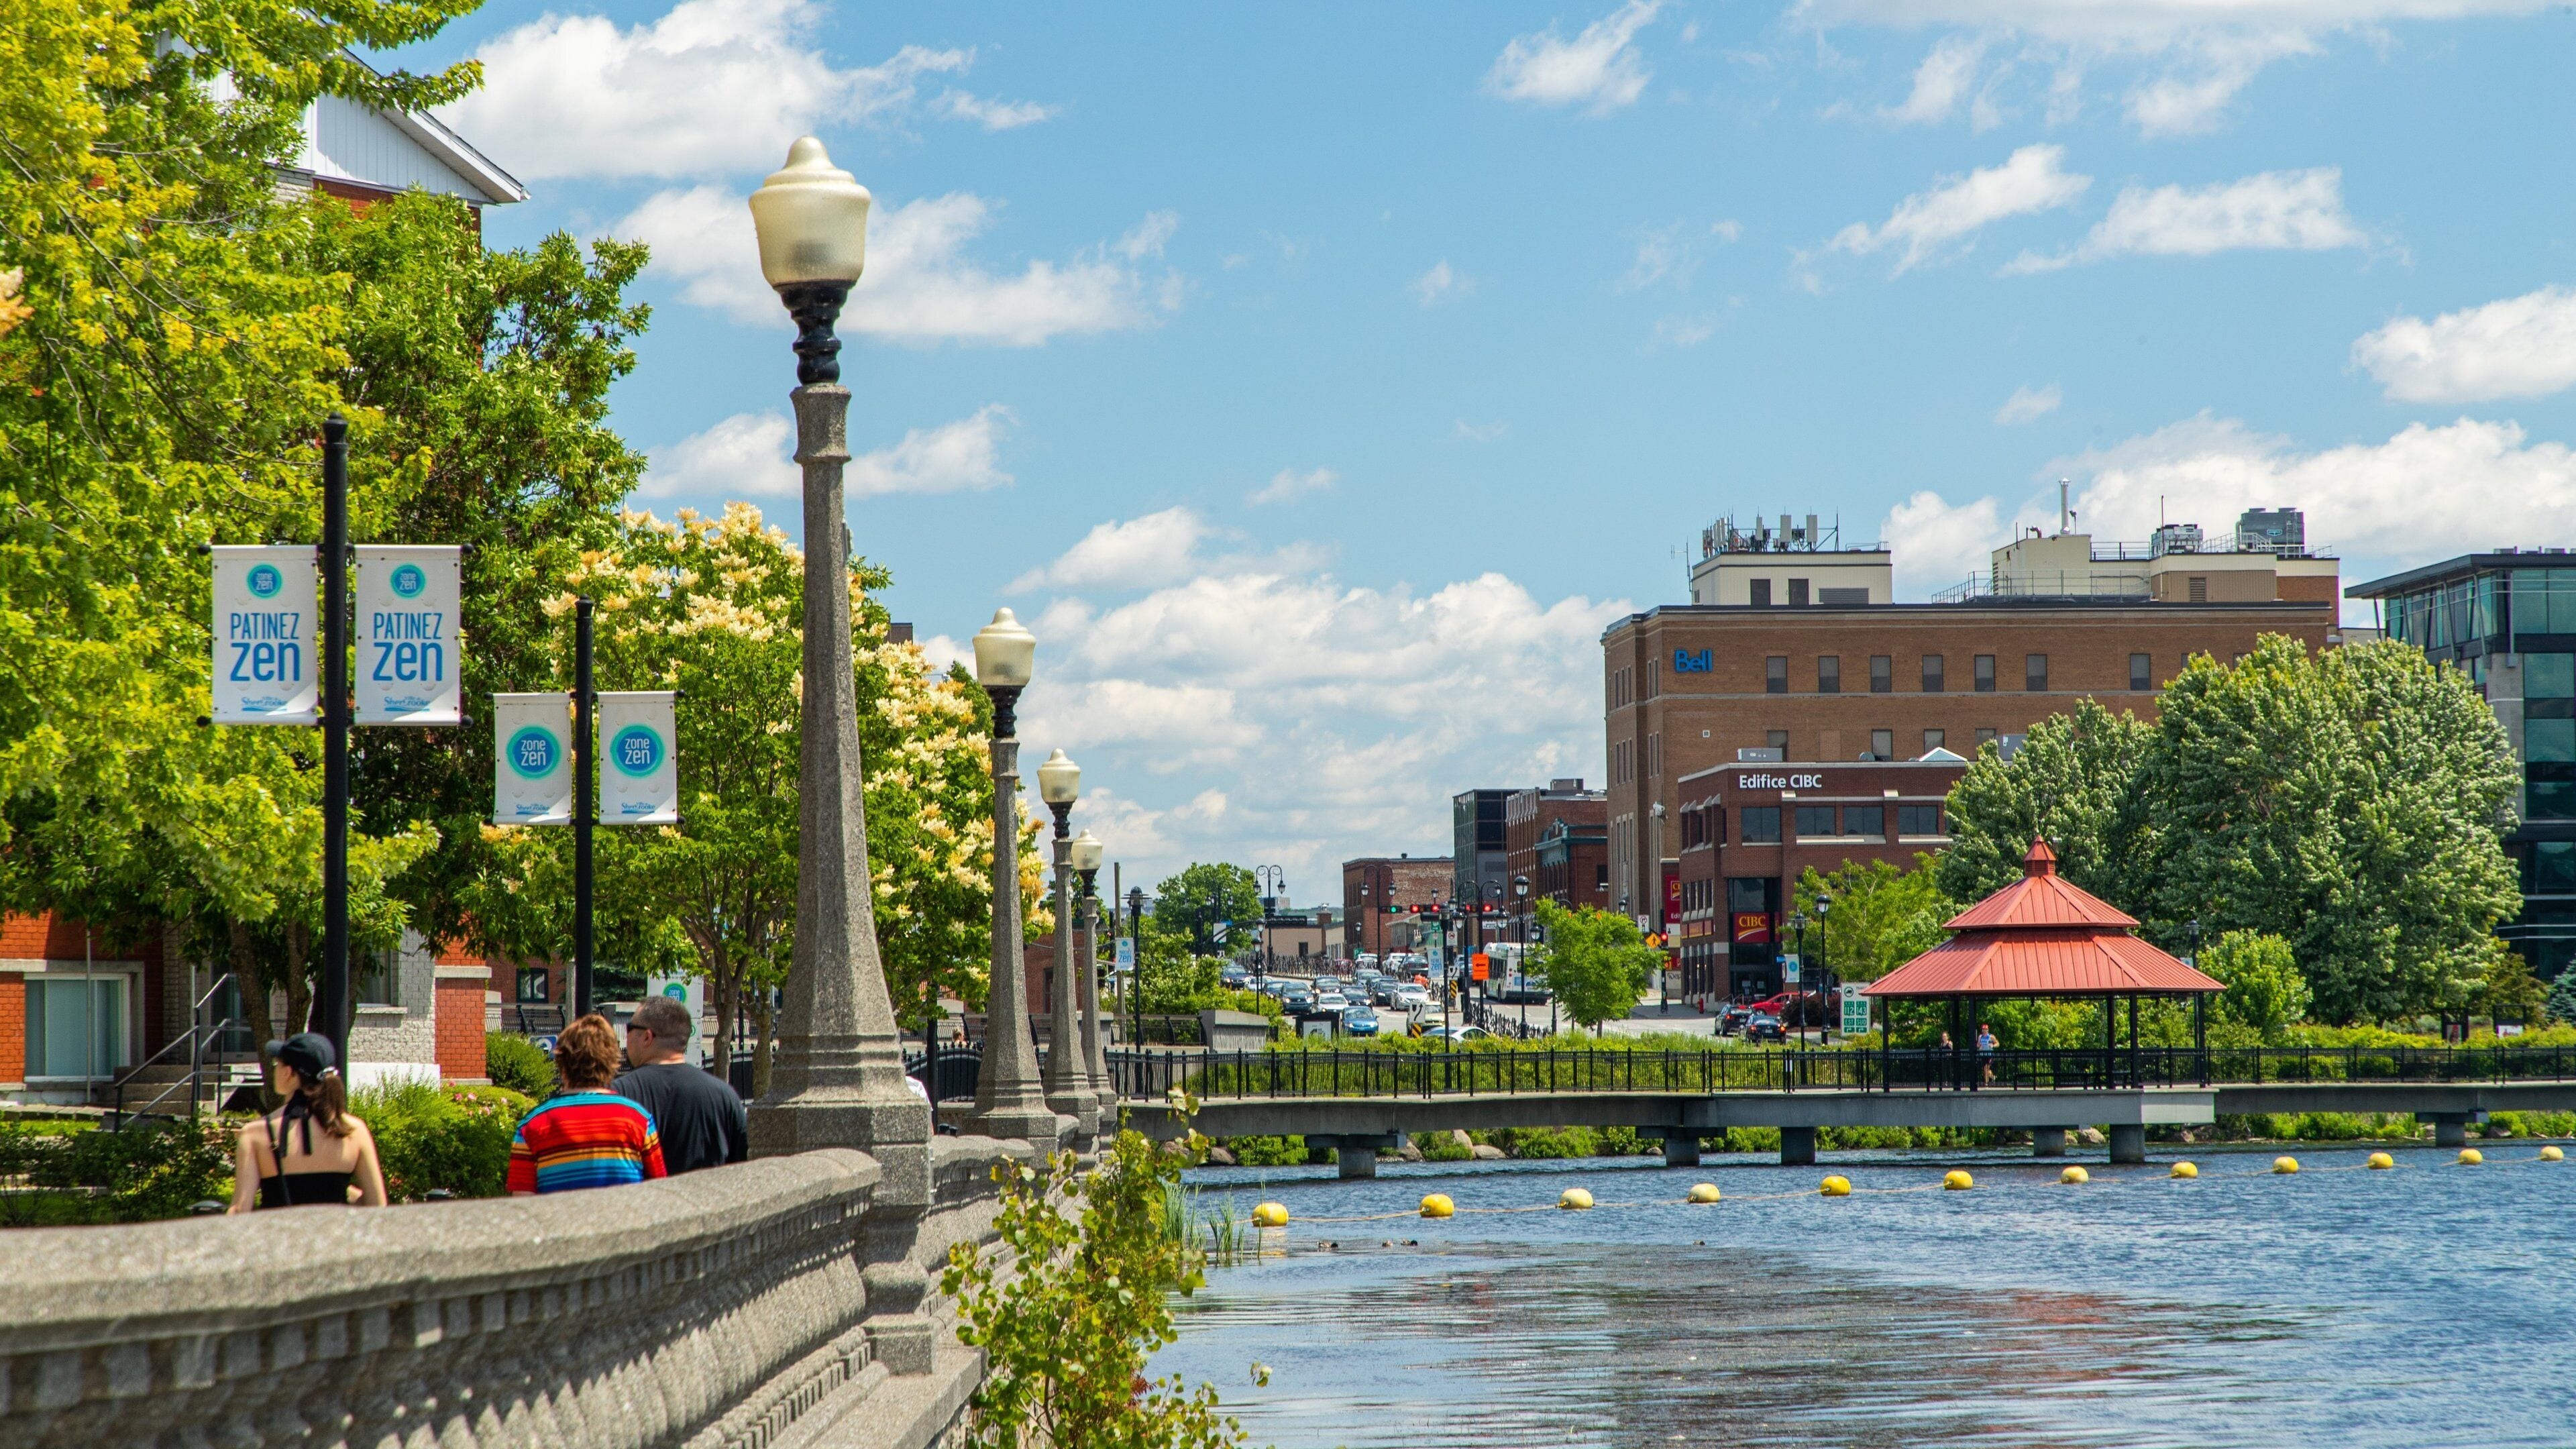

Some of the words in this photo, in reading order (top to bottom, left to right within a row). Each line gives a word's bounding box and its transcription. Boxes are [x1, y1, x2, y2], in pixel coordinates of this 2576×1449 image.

[256, 581, 274, 590] zen
[398, 581, 417, 590] zen
[231, 612, 300, 639] PATINEZ
[374, 612, 443, 639] PATINEZ
[230, 642, 300, 681] zen
[373, 642, 443, 681] zen
[1675, 649, 1713, 672] Bell
[521, 740, 546, 751] zone
[625, 739, 649, 749] zone
[521, 751, 546, 765] zen
[625, 750, 650, 764] zen
[1739, 774, 1786, 788] Edifice
[1790, 774, 1822, 788] CIBC
[1739, 916, 1766, 927] CIBC
[1118, 955, 1132, 963] zen
[1431, 963, 1442, 971] zen
[1845, 1007, 1854, 1015] 112
[1856, 1007, 1866, 1015] 143
